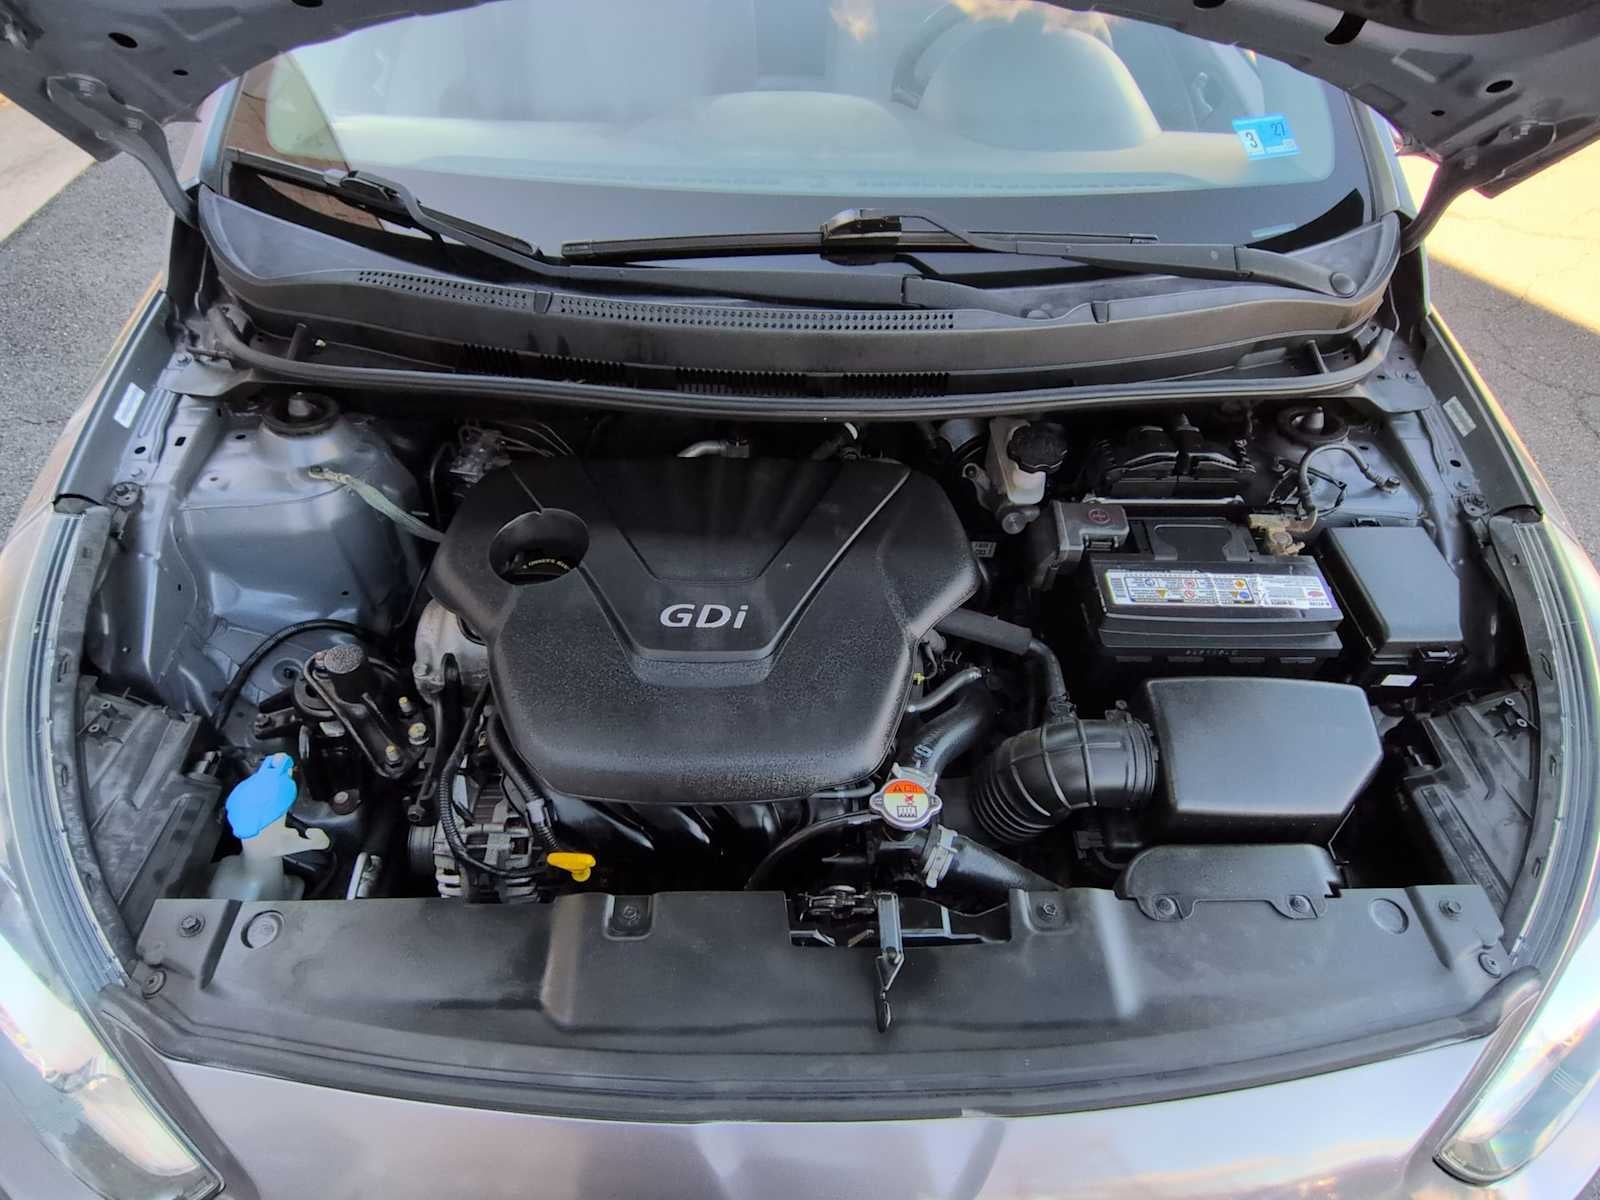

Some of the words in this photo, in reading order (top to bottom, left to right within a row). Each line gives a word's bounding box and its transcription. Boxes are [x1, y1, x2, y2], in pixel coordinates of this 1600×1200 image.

[1270, 121, 1286, 137] 27
[1245, 131, 1258, 148] 3
[660, 603, 749, 629] GDi
